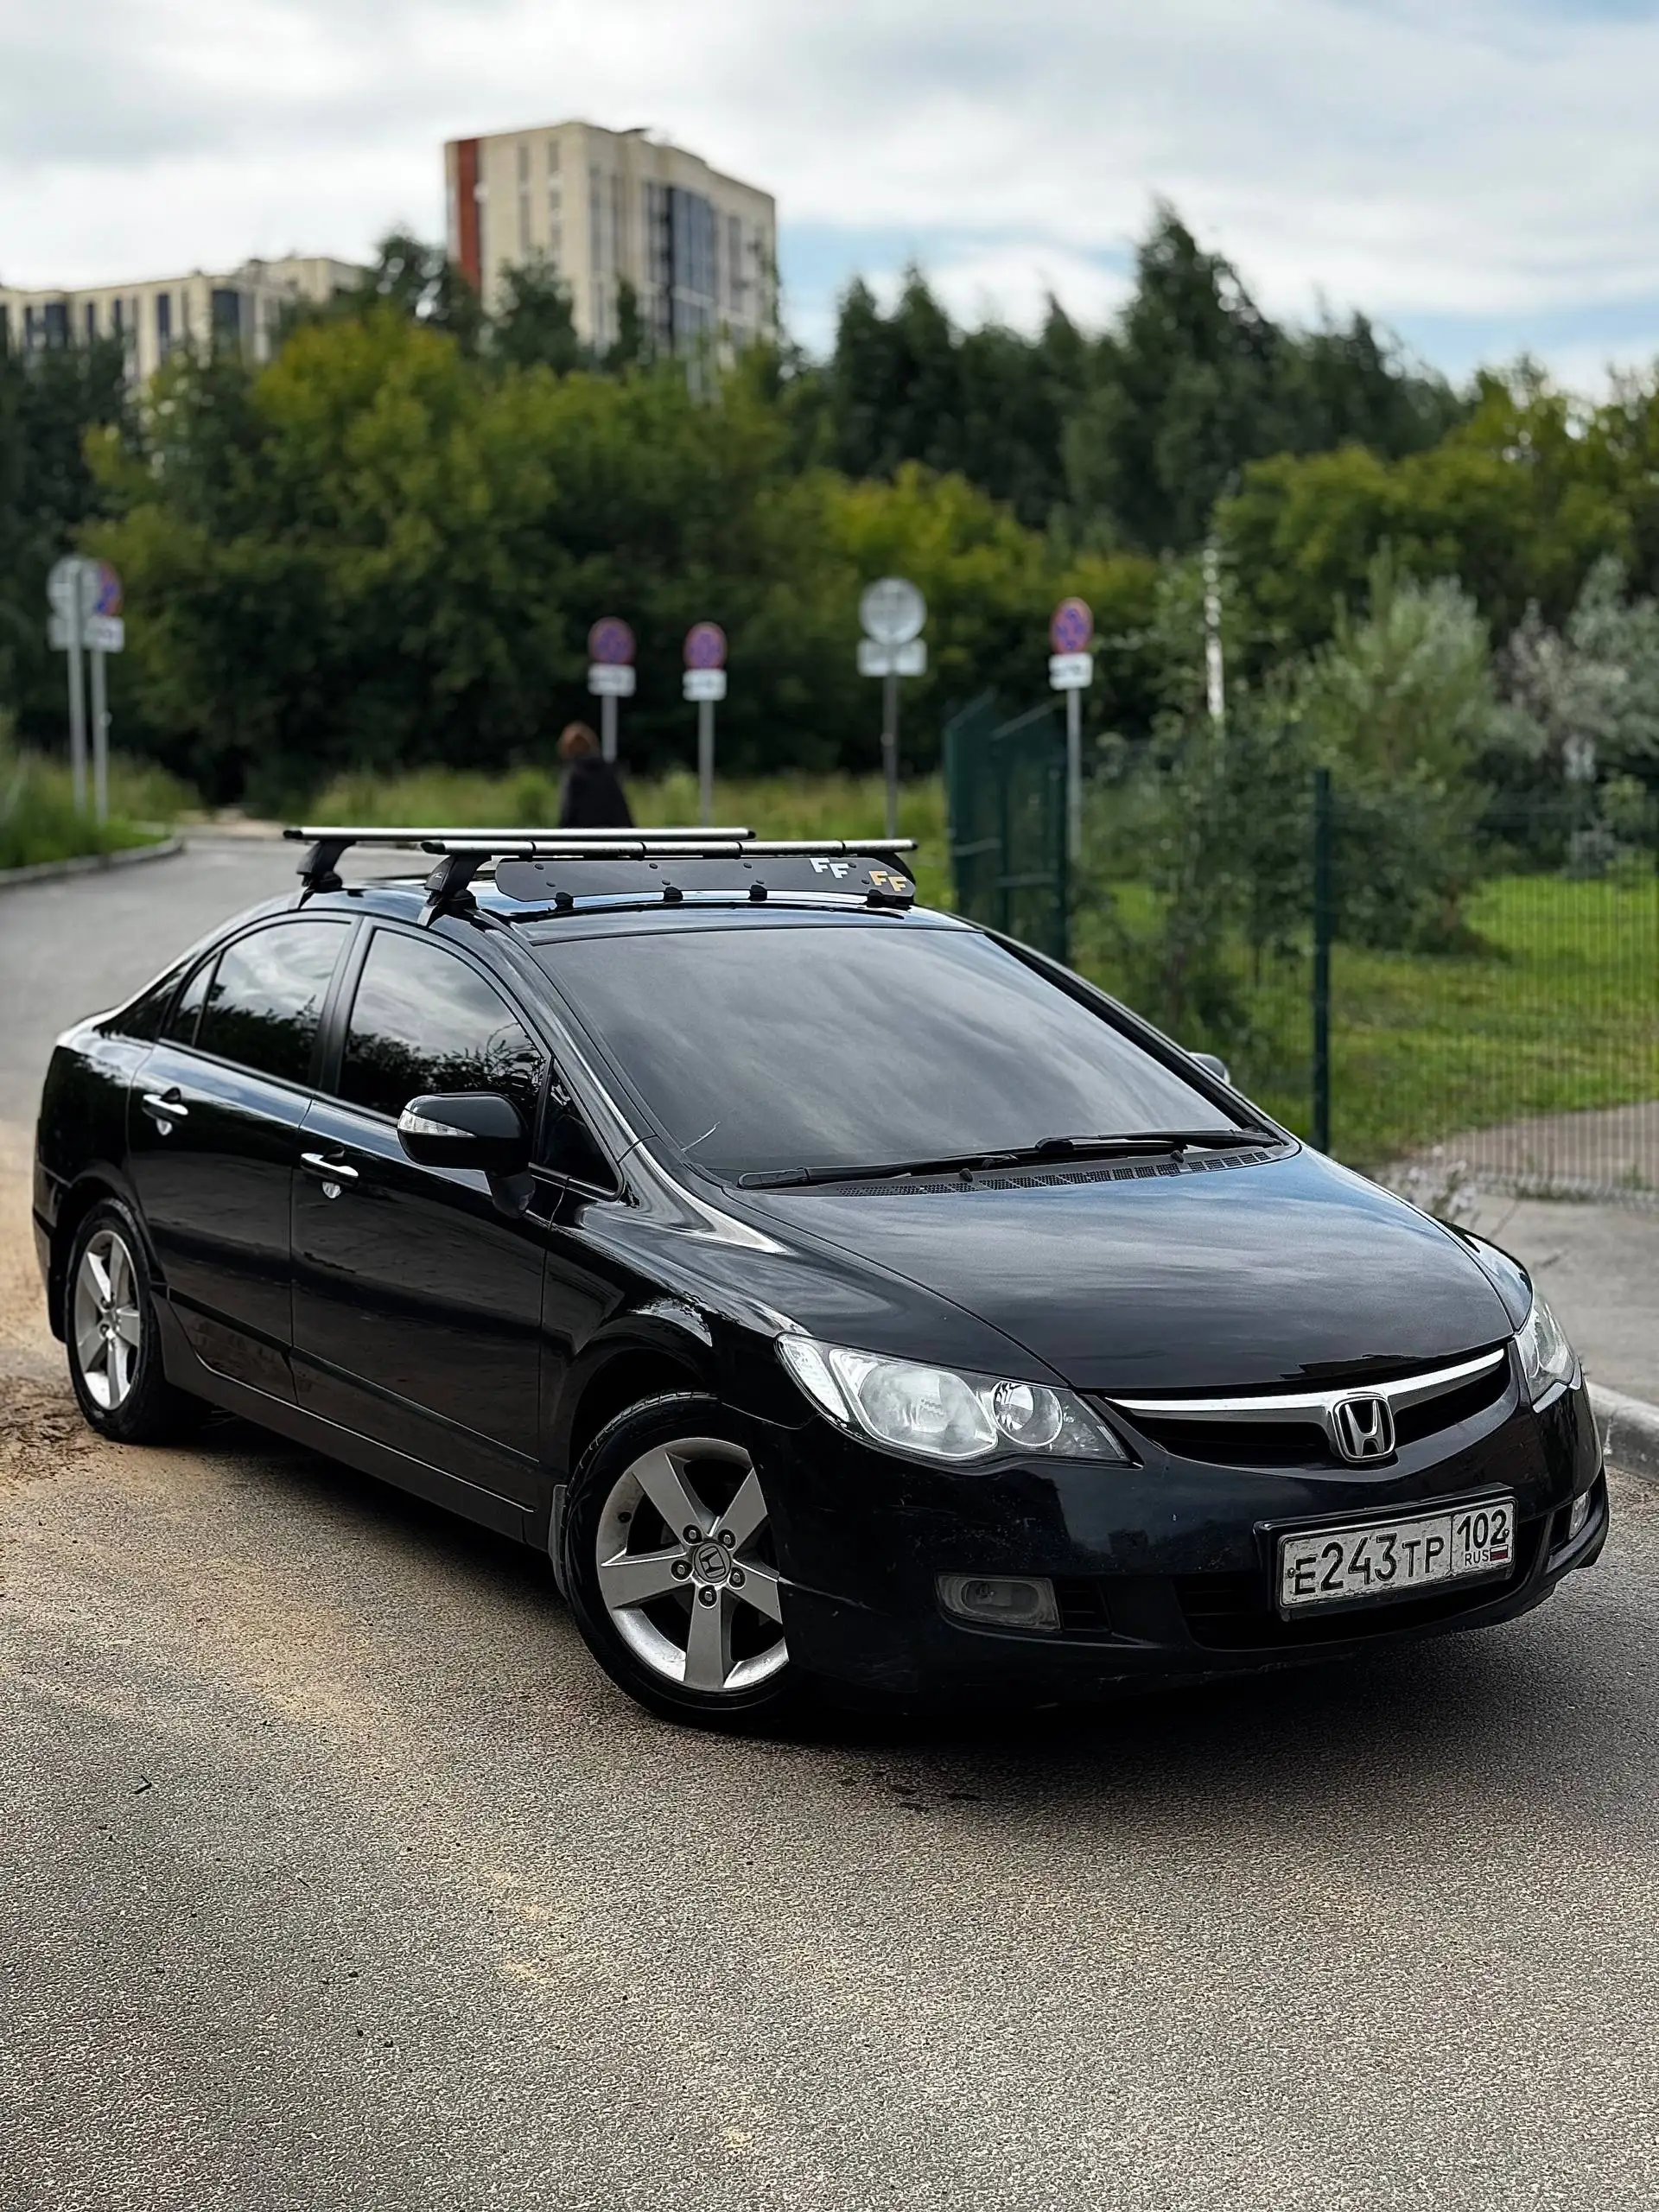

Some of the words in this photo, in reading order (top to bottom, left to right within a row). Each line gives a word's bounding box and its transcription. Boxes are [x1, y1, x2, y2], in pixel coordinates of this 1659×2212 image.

[810, 858, 849, 879] FF
[868, 870, 907, 892] FF
[1295, 1532, 1445, 1596] Е243ТР
[1457, 1509, 1507, 1552] 102
[1465, 1549, 1489, 1567] RUS
